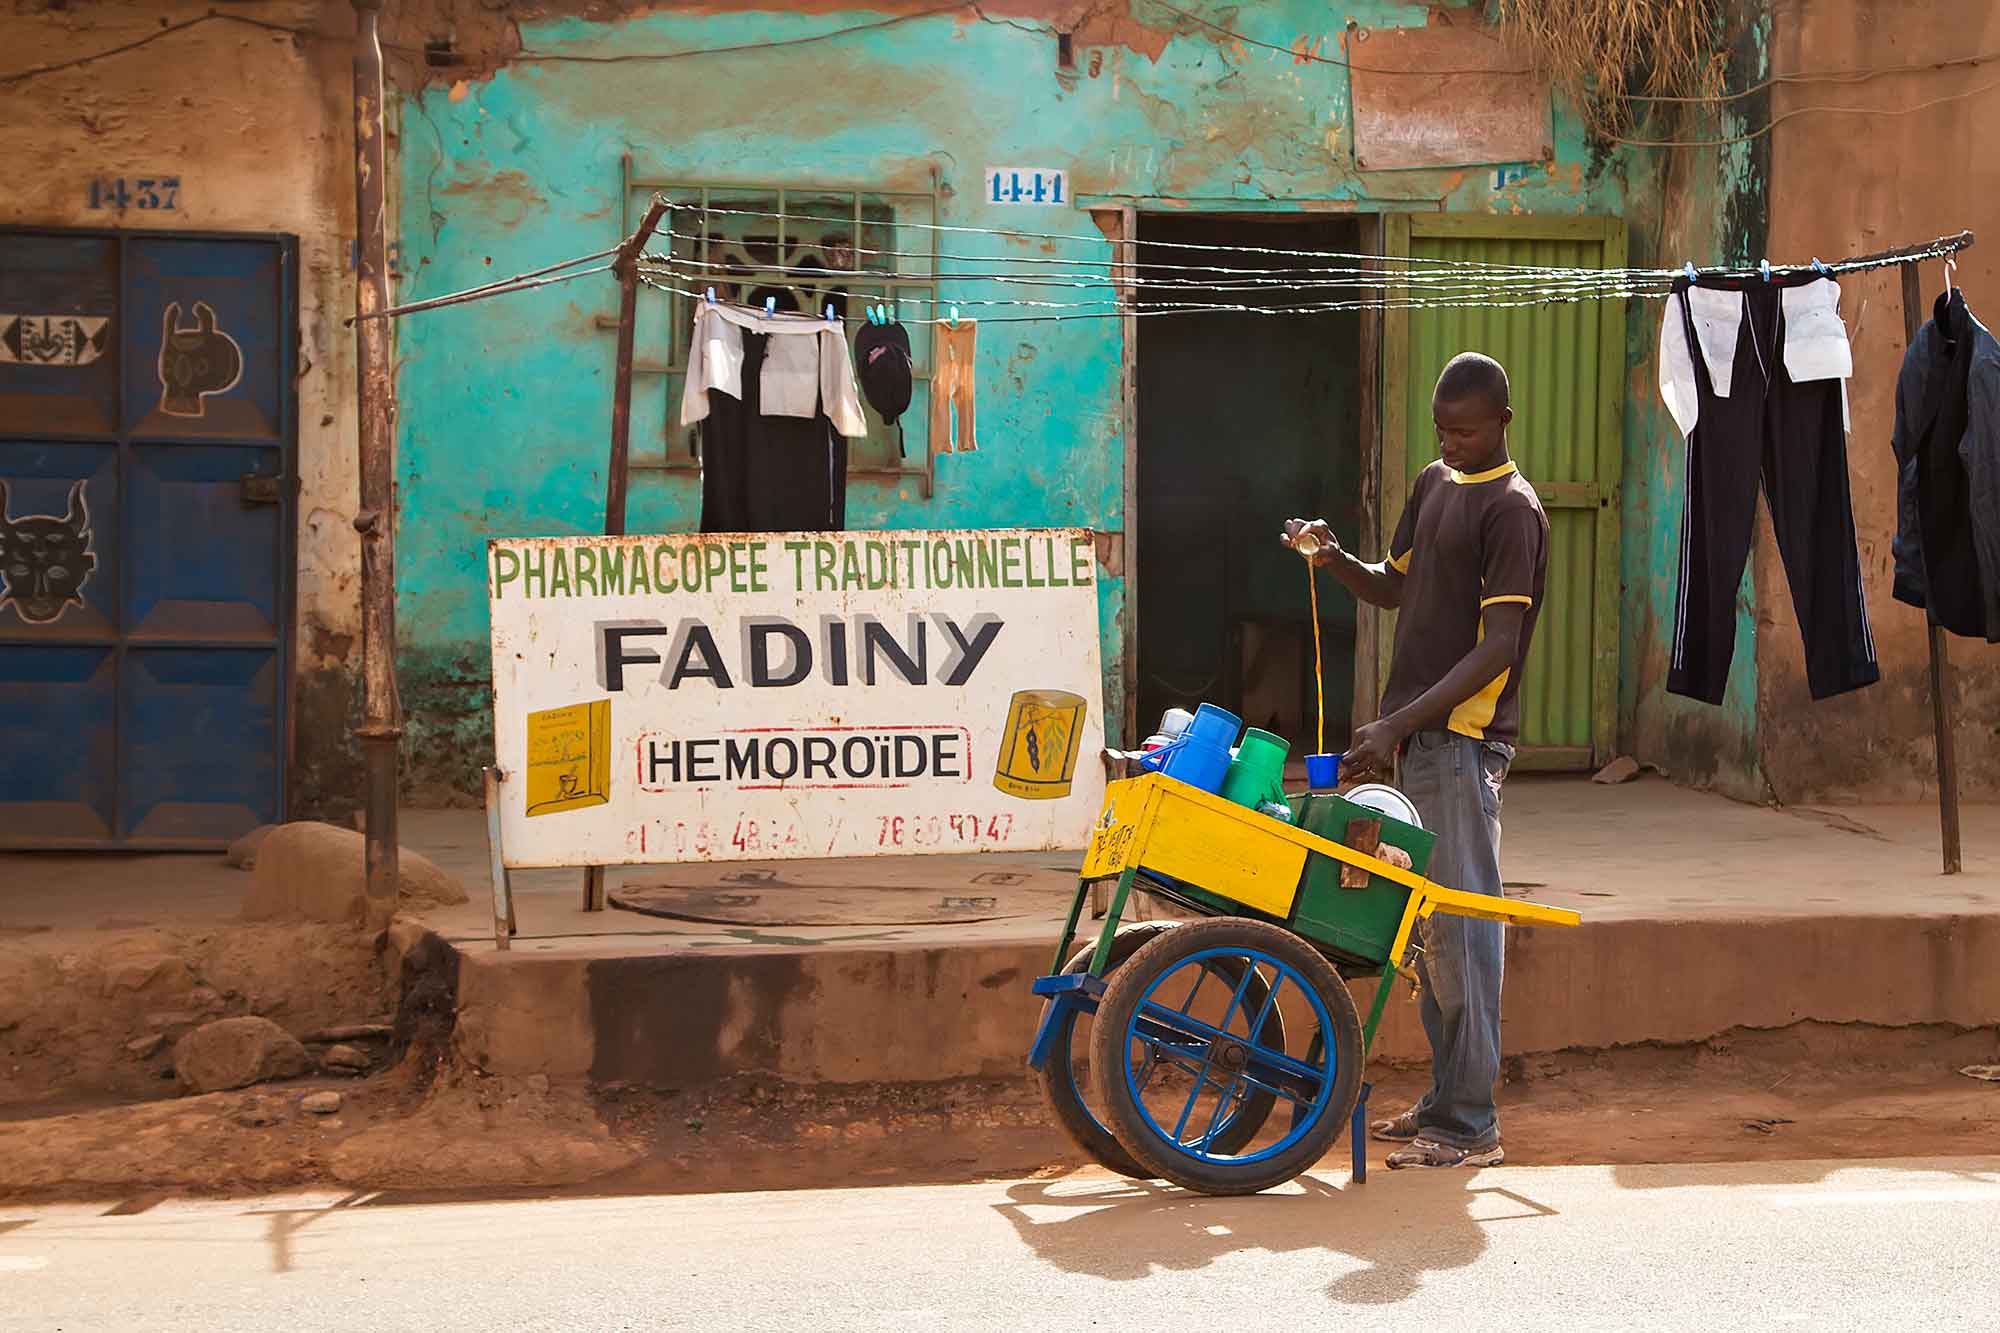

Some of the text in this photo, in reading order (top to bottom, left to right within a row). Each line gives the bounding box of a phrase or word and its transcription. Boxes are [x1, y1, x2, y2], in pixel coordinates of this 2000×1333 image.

[88, 177, 181, 209] 1437
[991, 171, 1065, 203] 1441
[494, 537, 1093, 599] PHARMACOPEE TRADITIONNELLE
[594, 613, 1005, 692] FADINY
